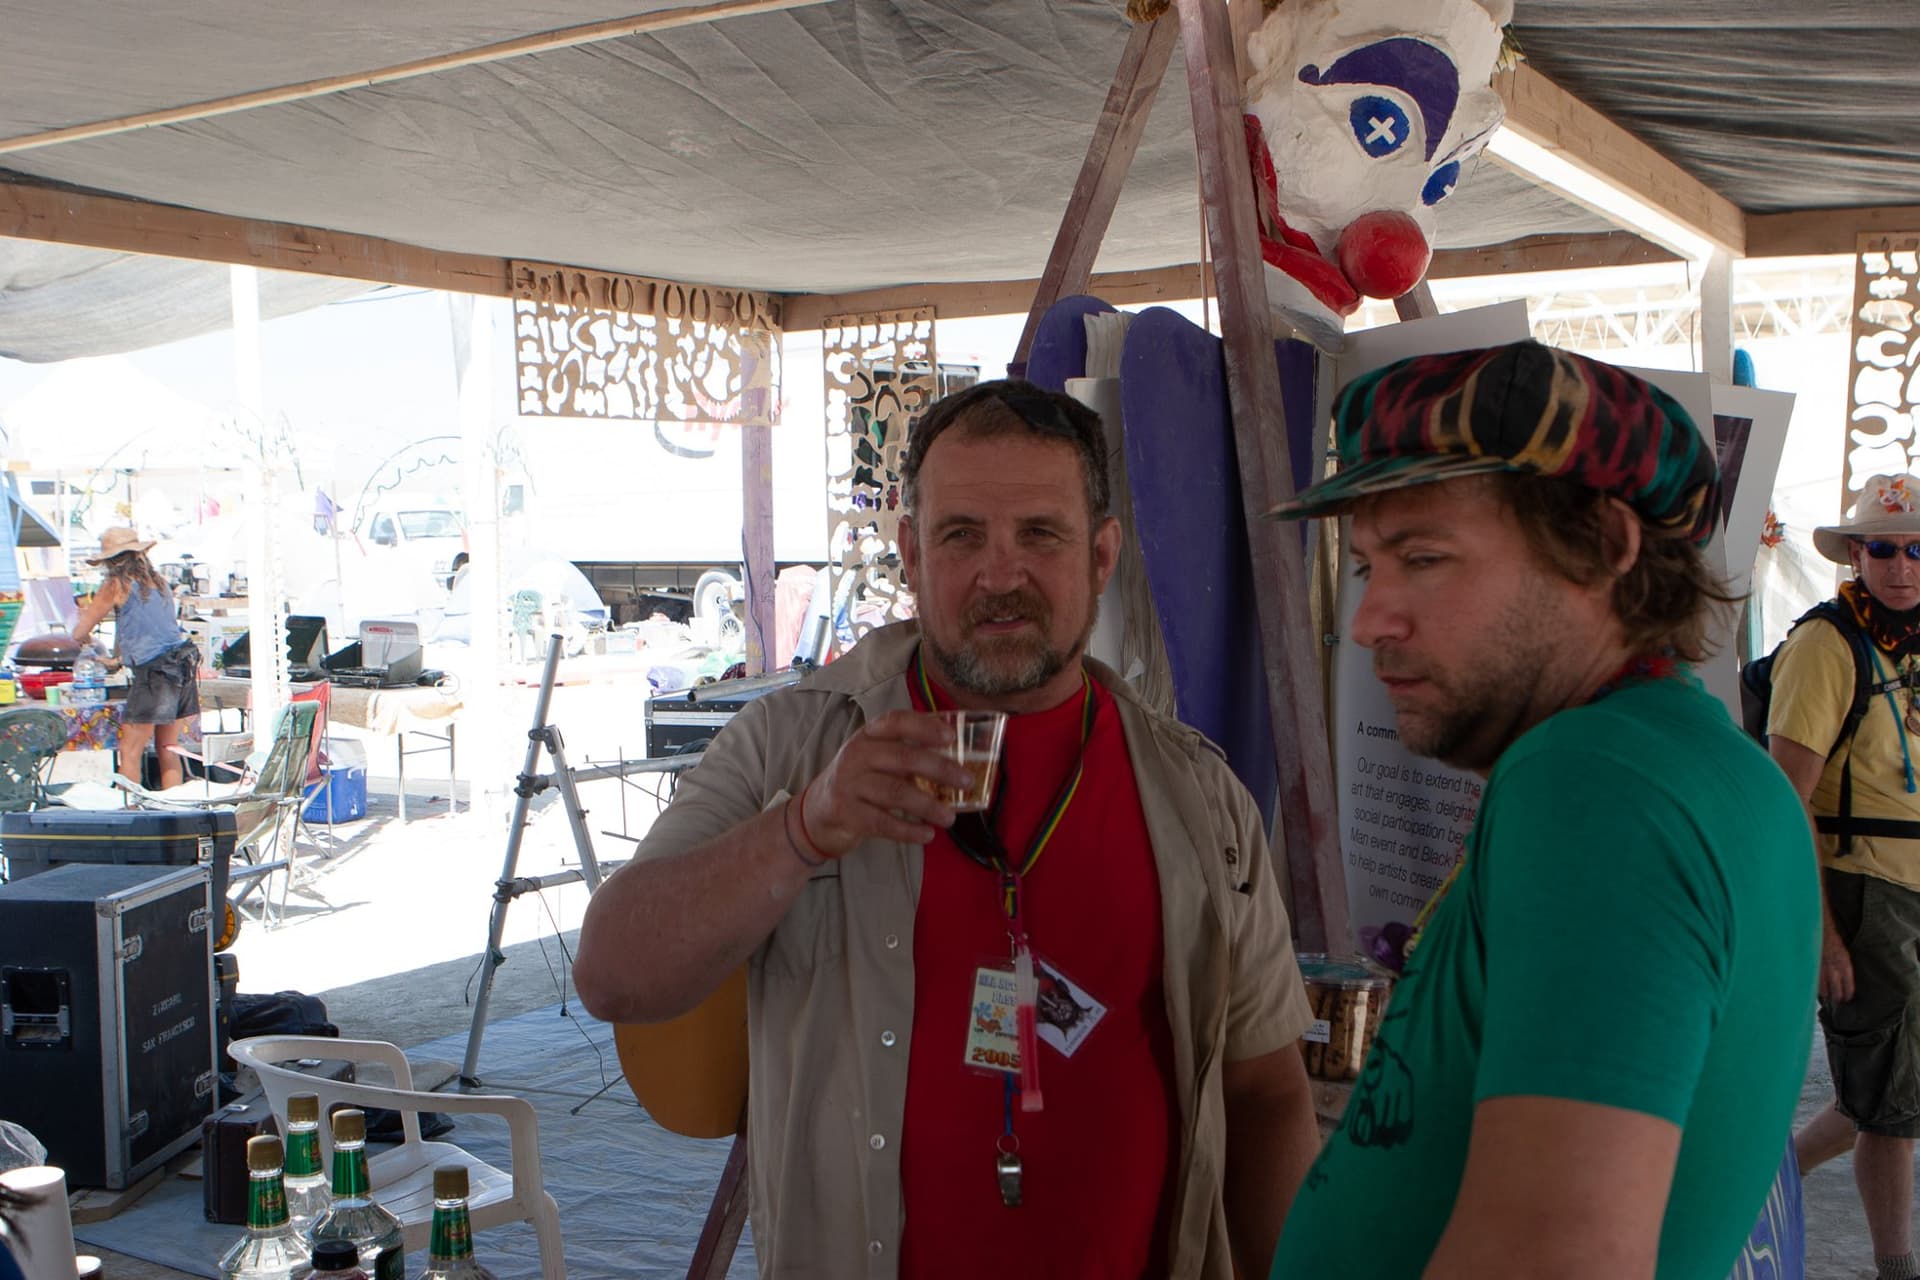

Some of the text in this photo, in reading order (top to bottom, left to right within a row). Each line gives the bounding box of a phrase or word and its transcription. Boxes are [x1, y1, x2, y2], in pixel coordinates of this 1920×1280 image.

[1356, 720, 1400, 742] A comm
[1357, 756, 1481, 797] Our goal is to extend the
[1351, 783, 1363, 797] art
[1365, 783, 1384, 801] that
[1386, 791, 1432, 814] engages,
[1353, 807, 1380, 825] social
[1380, 814, 1446, 841] participation
[1351, 826, 1369, 847] Man
[1370, 836, 1397, 854] event
[1398, 843, 1420, 860] and
[1420, 845, 1453, 868] Black
[1349, 849, 1357, 867] to
[1358, 853, 1377, 875] help
[1377, 860, 1408, 882] artists
[1369, 883, 1390, 901] own
